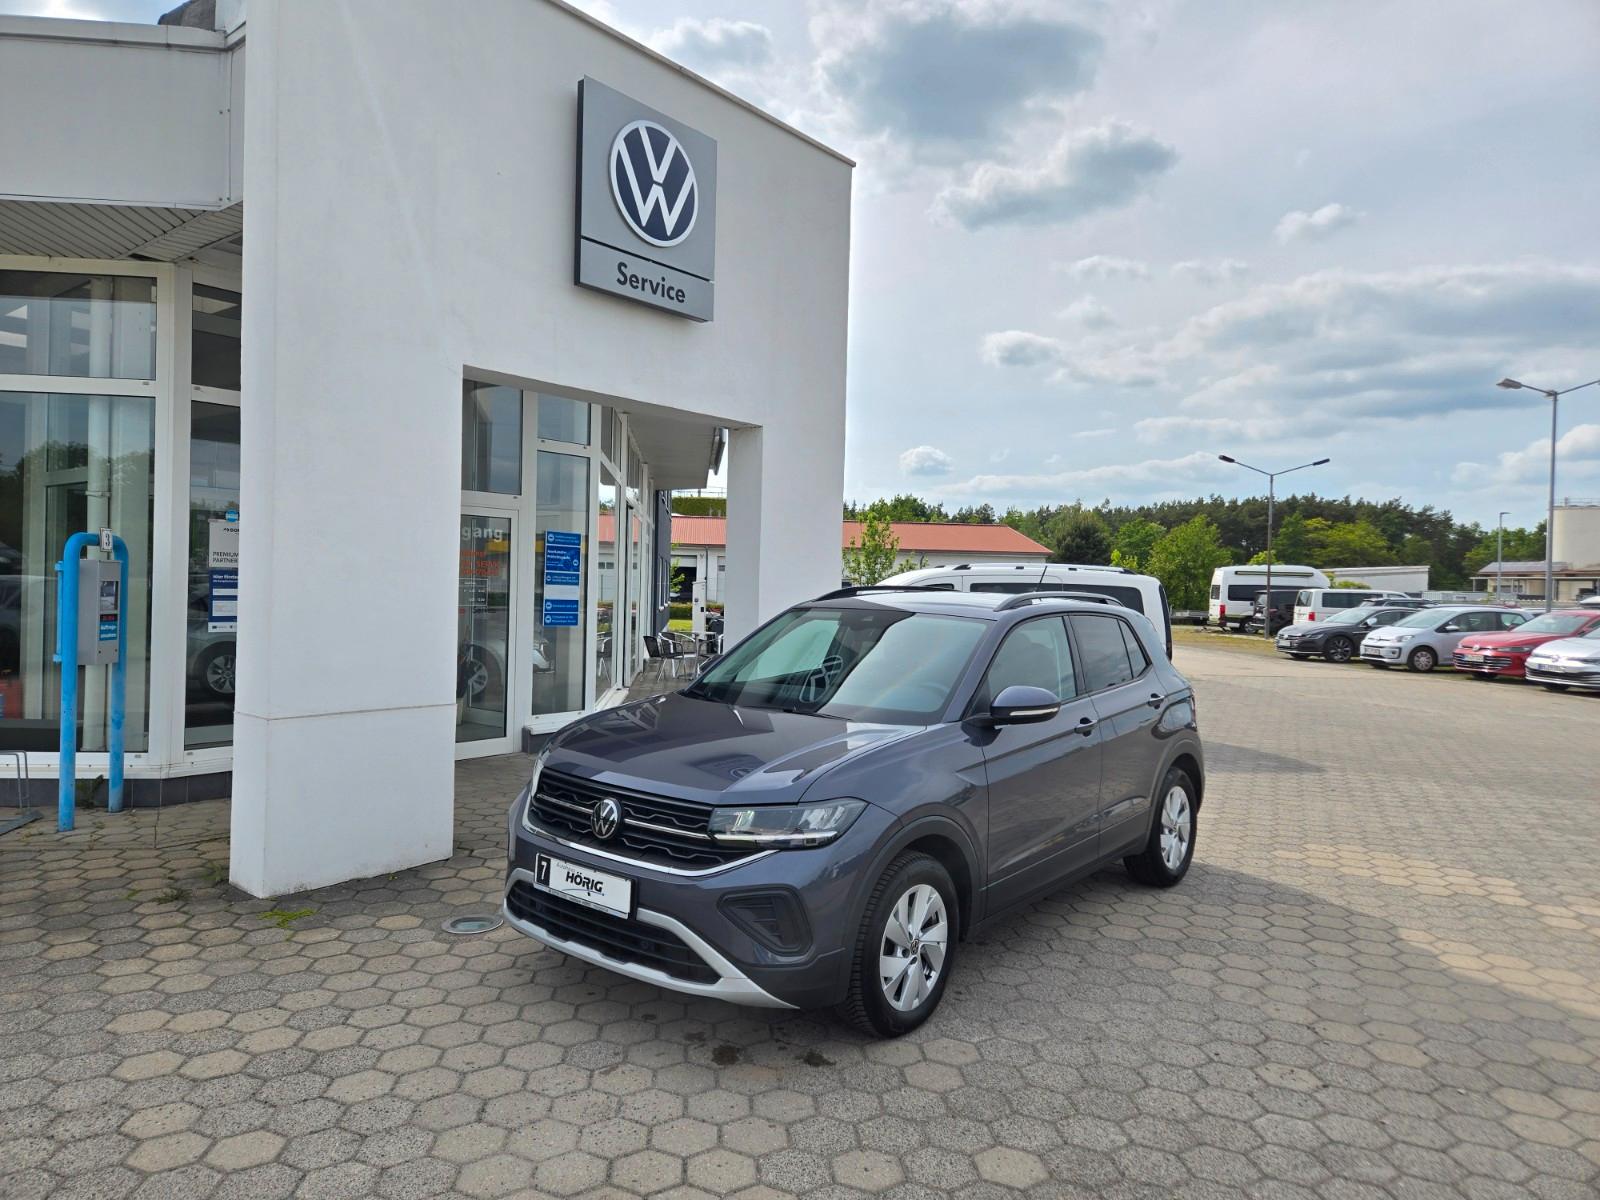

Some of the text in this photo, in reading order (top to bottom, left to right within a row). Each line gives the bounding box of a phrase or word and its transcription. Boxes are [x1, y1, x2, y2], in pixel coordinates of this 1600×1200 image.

[612, 121, 699, 246] VW
[616, 261, 686, 304] Service
[541, 861, 547, 880] 7
[565, 872, 603, 894] HÖRIG
